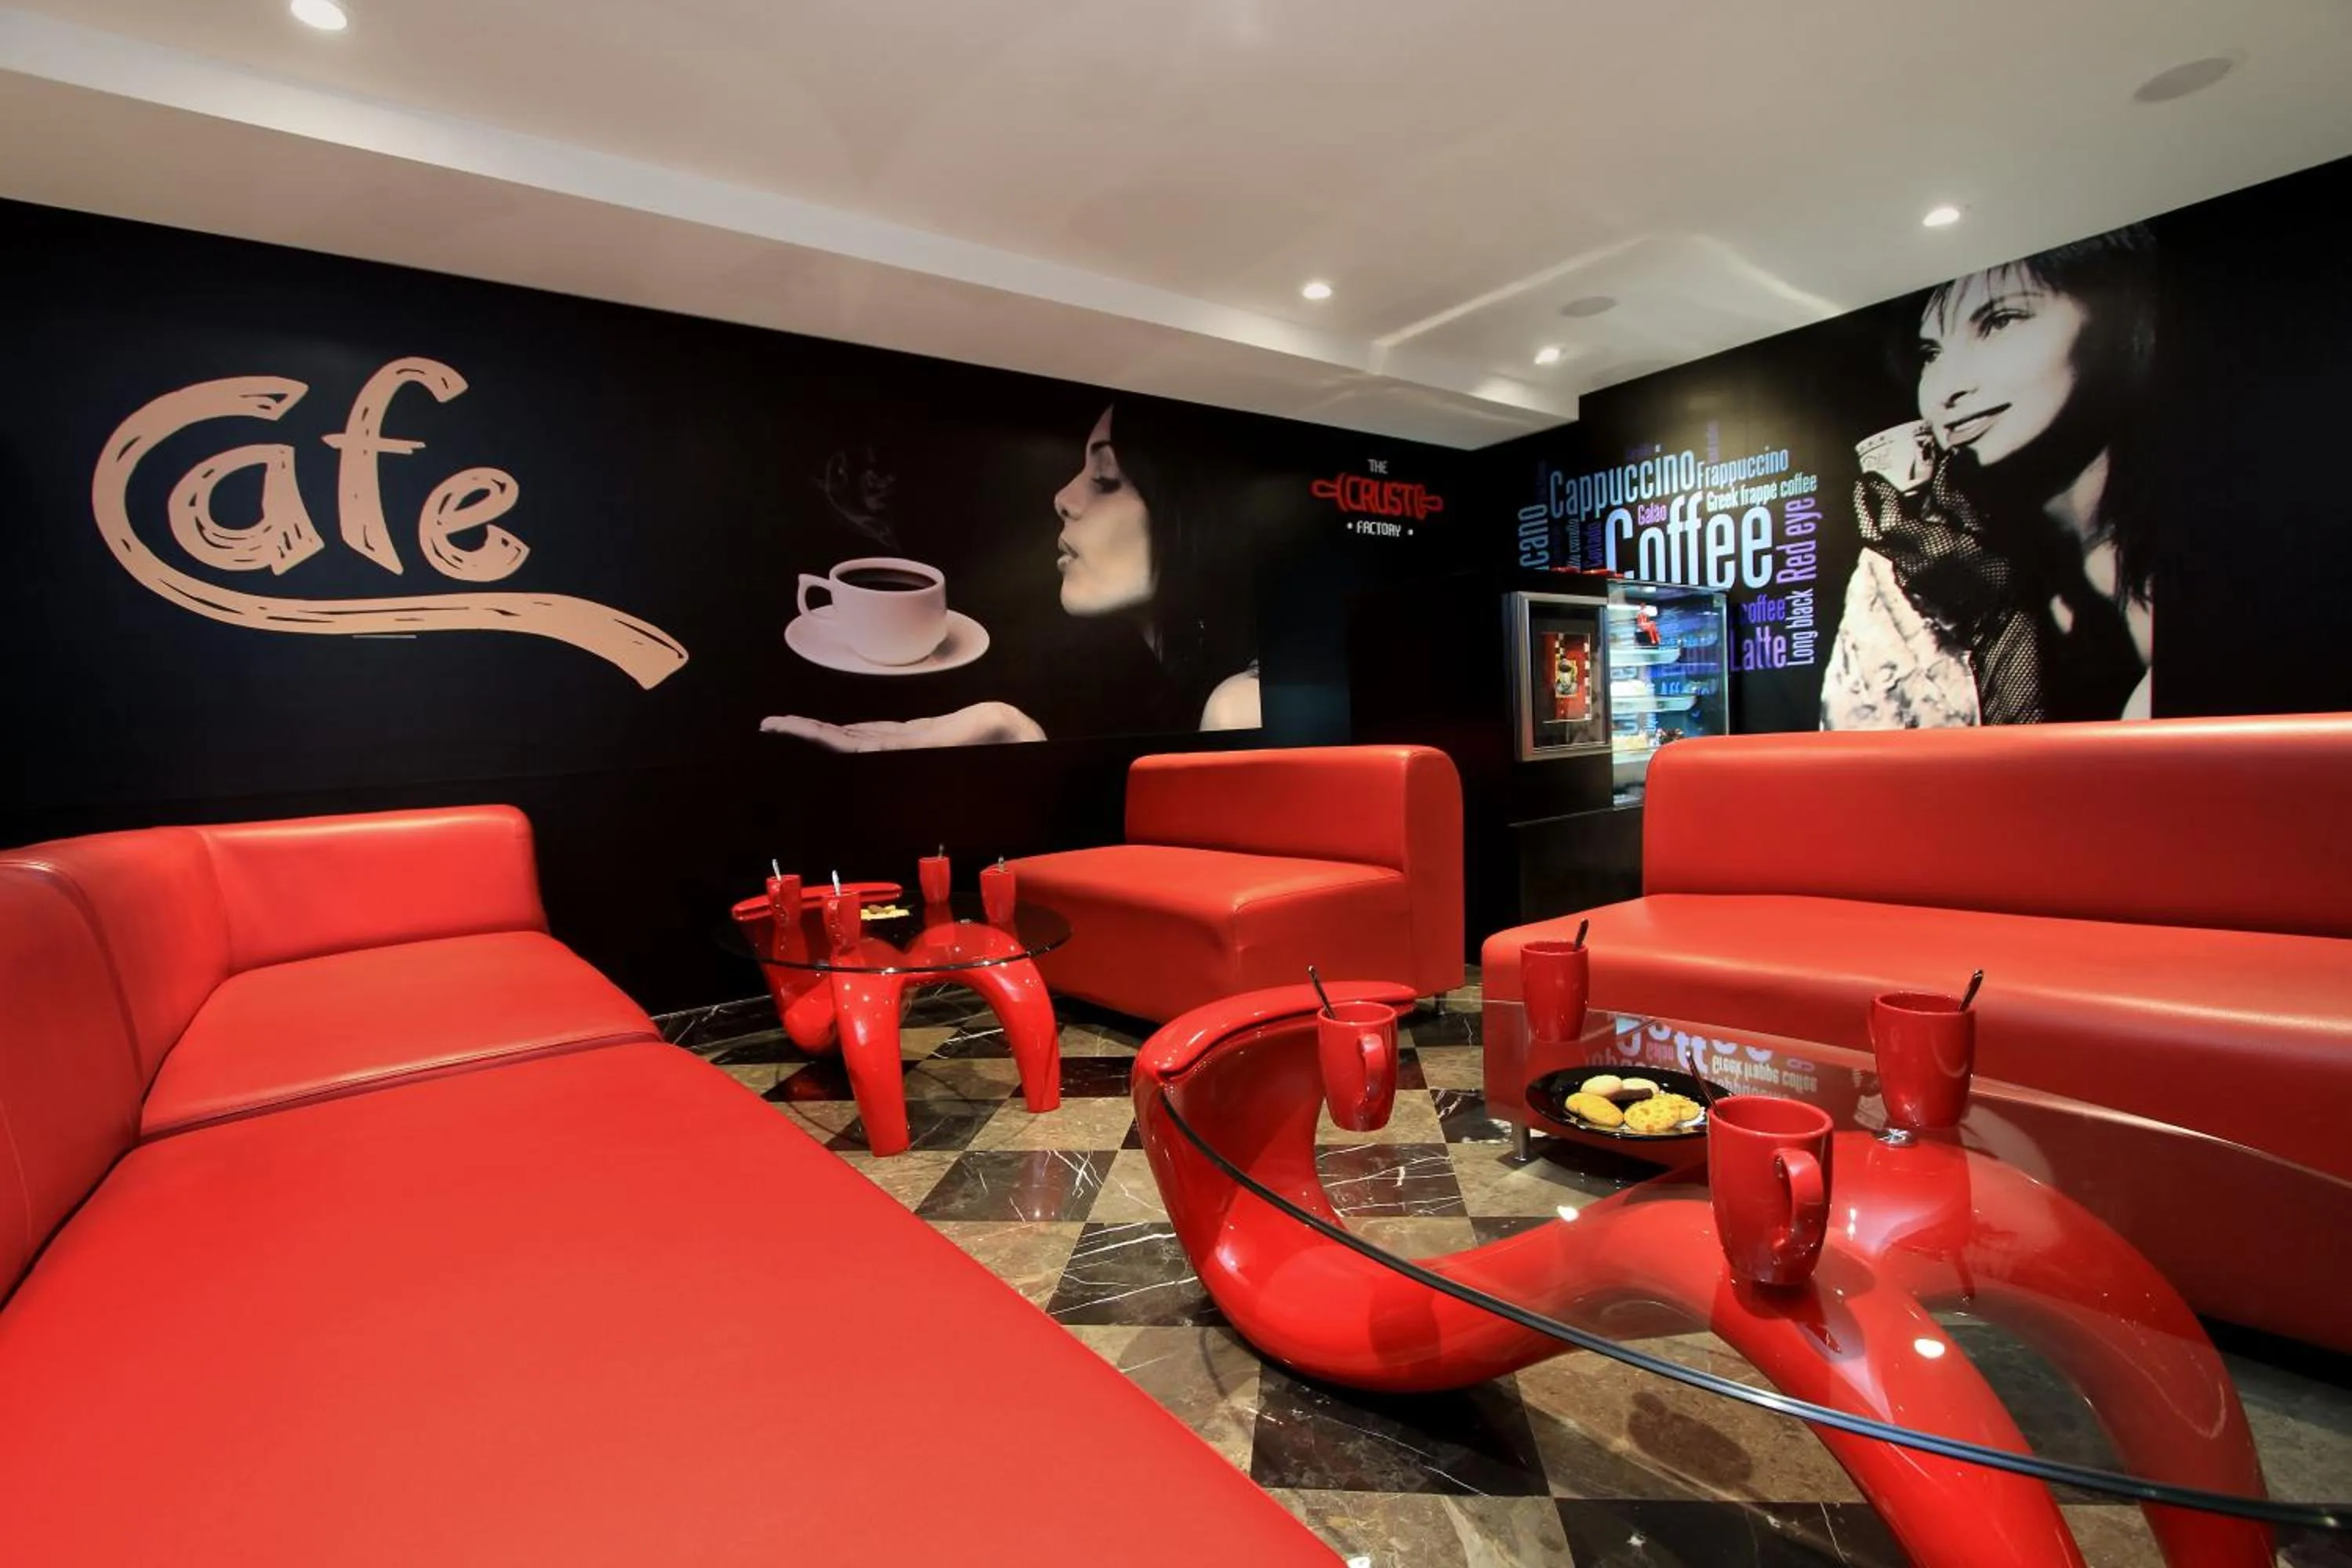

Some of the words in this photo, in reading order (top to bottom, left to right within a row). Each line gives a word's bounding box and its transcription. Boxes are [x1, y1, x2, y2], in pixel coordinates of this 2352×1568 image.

[1367, 459, 1388, 474] THE
[1550, 445, 1695, 522] Cappuccino
[1697, 446, 1788, 490] Frappuccino
[1707, 488, 1738, 512] Greek
[1780, 472, 1817, 498] coffee
[92, 356, 689, 690] Cafe
[1356, 520, 1402, 537] FACTORY
[1784, 497, 1823, 535] eye
[1605, 495, 1773, 589] Coffee
[1776, 539, 1817, 584] Red
[1785, 588, 1814, 628] black
[1730, 626, 1787, 671] Latte
[1785, 630, 1818, 666] Long
